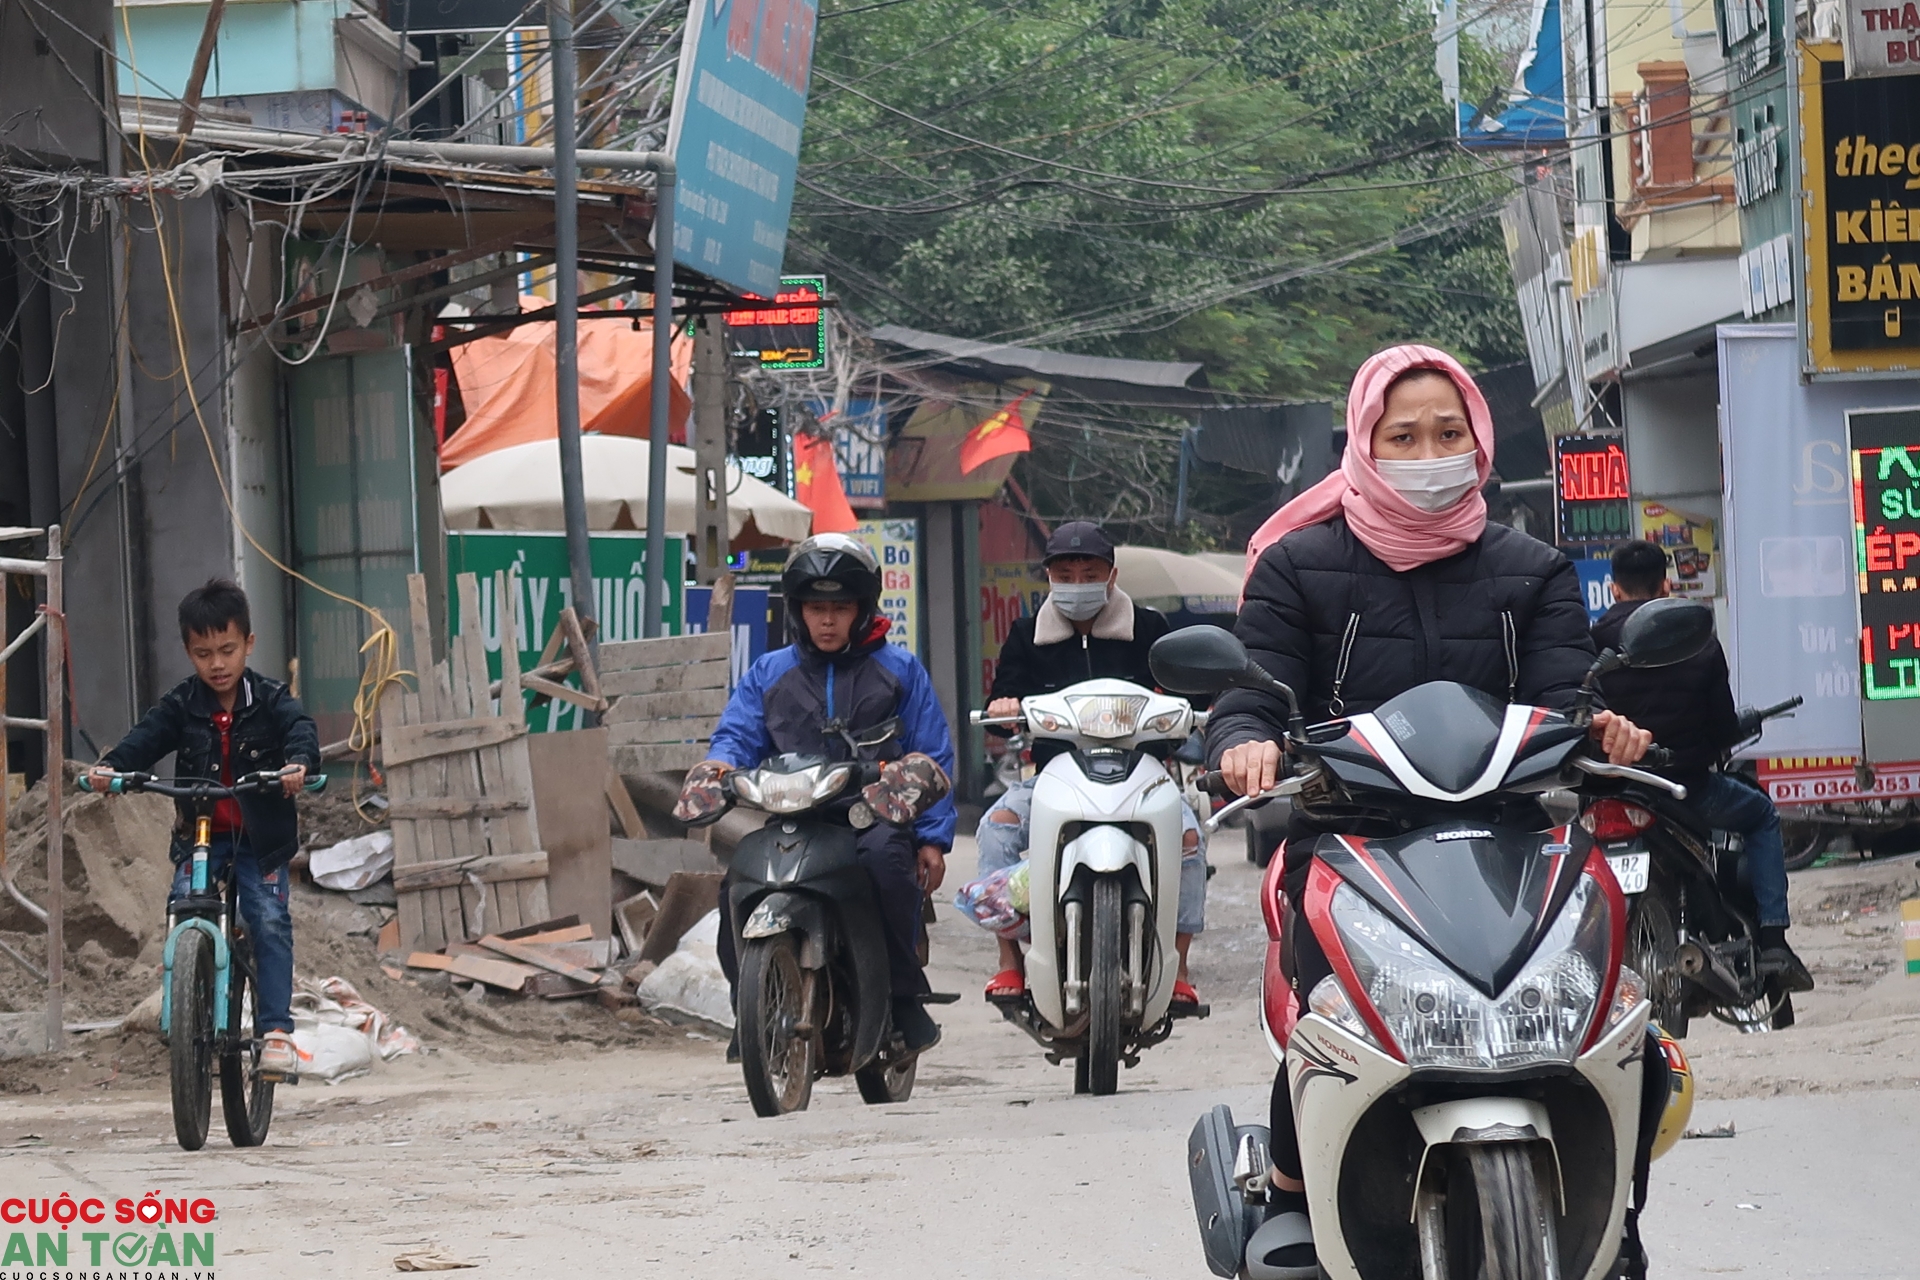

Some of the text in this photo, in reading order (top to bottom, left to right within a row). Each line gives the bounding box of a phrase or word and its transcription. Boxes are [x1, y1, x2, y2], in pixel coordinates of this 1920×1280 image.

[1562, 445, 1629, 500] NHÀ
[851, 480, 880, 495] WIFI
[884, 545, 911, 565] Bò
[884, 570, 911, 590] Gà
[1436, 830, 1494, 841] HONDA
[1316, 1033, 1360, 1066] HONDA
